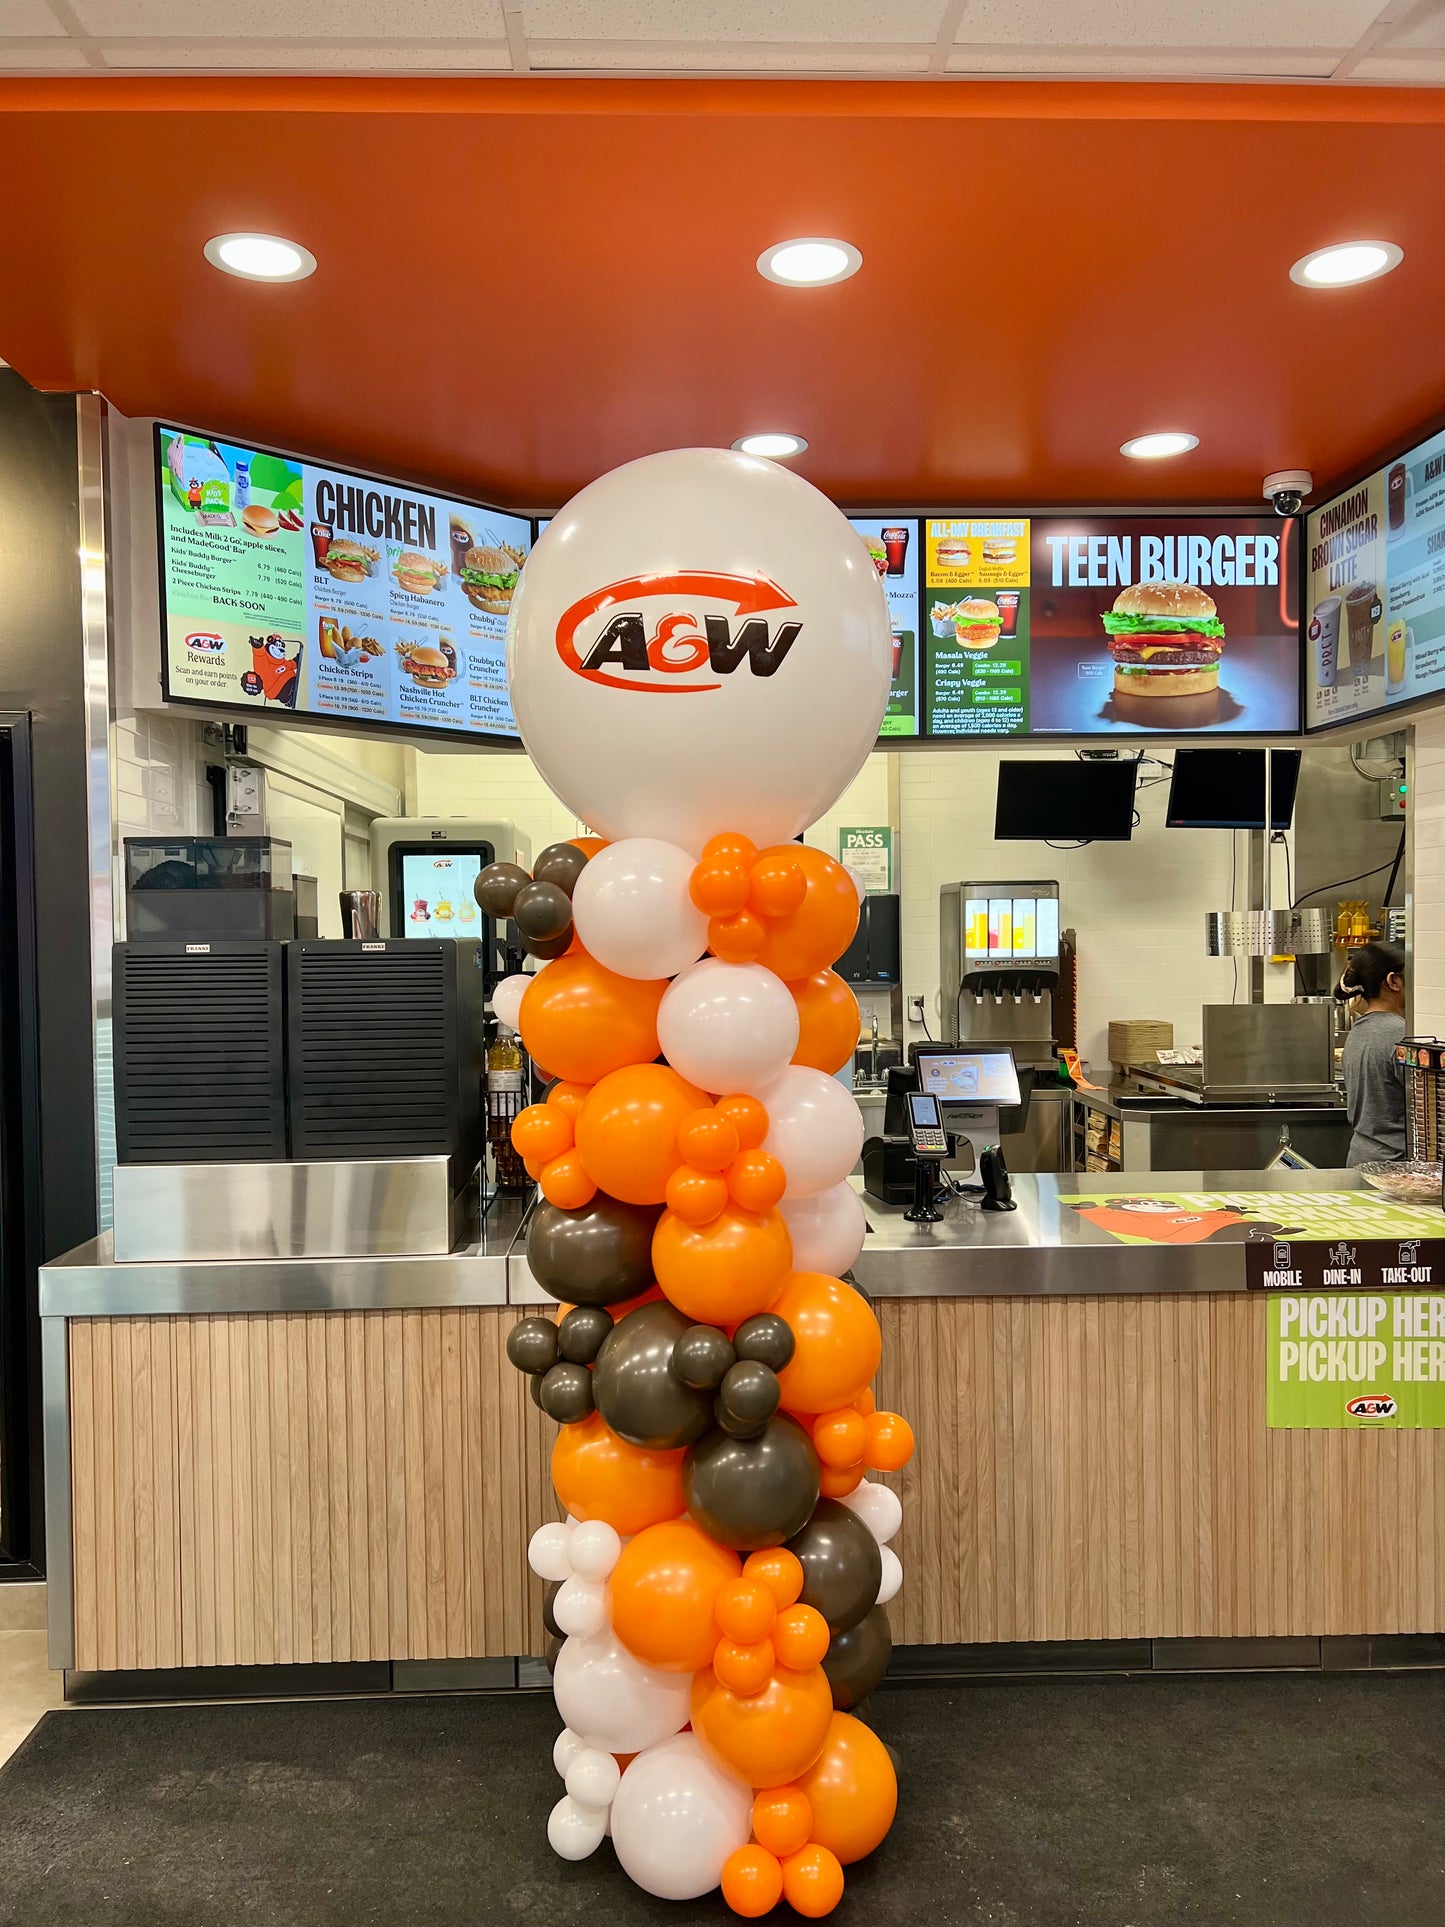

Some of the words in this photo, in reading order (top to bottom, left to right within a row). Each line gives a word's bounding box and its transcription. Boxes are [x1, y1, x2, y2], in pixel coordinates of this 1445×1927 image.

[1425, 456, 1442, 486] A&W
[316, 479, 436, 550] CHICKEN
[1320, 487, 1368, 539] CINNAMON
[931, 522, 969, 537] ALL-DAY
[971, 522, 1025, 537] BREAKFAST
[170, 524, 203, 537] Includes
[205, 531, 222, 541] Milk
[243, 540, 263, 550] apple
[265, 544, 287, 554] slices,
[1312, 531, 1344, 572] BROWN
[1346, 514, 1378, 554] SUGAR
[188, 549, 210, 560] Buddy
[233, 546, 246, 554] Bar
[1046, 535, 1132, 587] TEEN
[1140, 535, 1279, 586] BURGER
[172, 566, 216, 580] Cheeseburger
[314, 575, 328, 585] BLT
[1330, 554, 1357, 592] LATTE
[178, 578, 195, 588] Piece
[196, 581, 221, 592] Chicken
[222, 585, 241, 595] Strips
[213, 595, 237, 607] BACK
[240, 599, 266, 611] SOON
[390, 590, 409, 601] Spicy
[411, 594, 445, 607] Habanero
[190, 638, 225, 650] A&W
[579, 612, 804, 678] A&W
[187, 651, 225, 666] Rewards
[469, 655, 494, 668] Chubby
[964, 652, 988, 660] Veggie
[319, 664, 349, 675] Chicken
[351, 669, 373, 679] Strips
[469, 664, 499, 675] Cruncher
[1415, 659, 1437, 670] Strawberry
[176, 666, 191, 674] Scan
[219, 672, 237, 682] points
[400, 685, 431, 696] Nashville
[935, 679, 961, 687] Crispy
[962, 679, 986, 687] Veggie
[400, 694, 427, 704] Chicken
[484, 696, 508, 706] Chicken
[470, 703, 500, 714] Cruncher
[848, 834, 883, 847] PASS
[1178, 1193, 1352, 1207] PICKUP
[1256, 1206, 1388, 1222] ICKUP
[1290, 1220, 1430, 1238] CKUP
[1263, 1270, 1302, 1287] MOBILE
[1323, 1268, 1362, 1286] DINE-IN
[1381, 1266, 1432, 1284] TAKE-OUT
[1280, 1296, 1387, 1338] PICKUP
[1392, 1296, 1445, 1338] HER
[1280, 1340, 1387, 1382] PICKUP
[1392, 1340, 1445, 1382] HER
[1353, 1402, 1394, 1414] A&W
